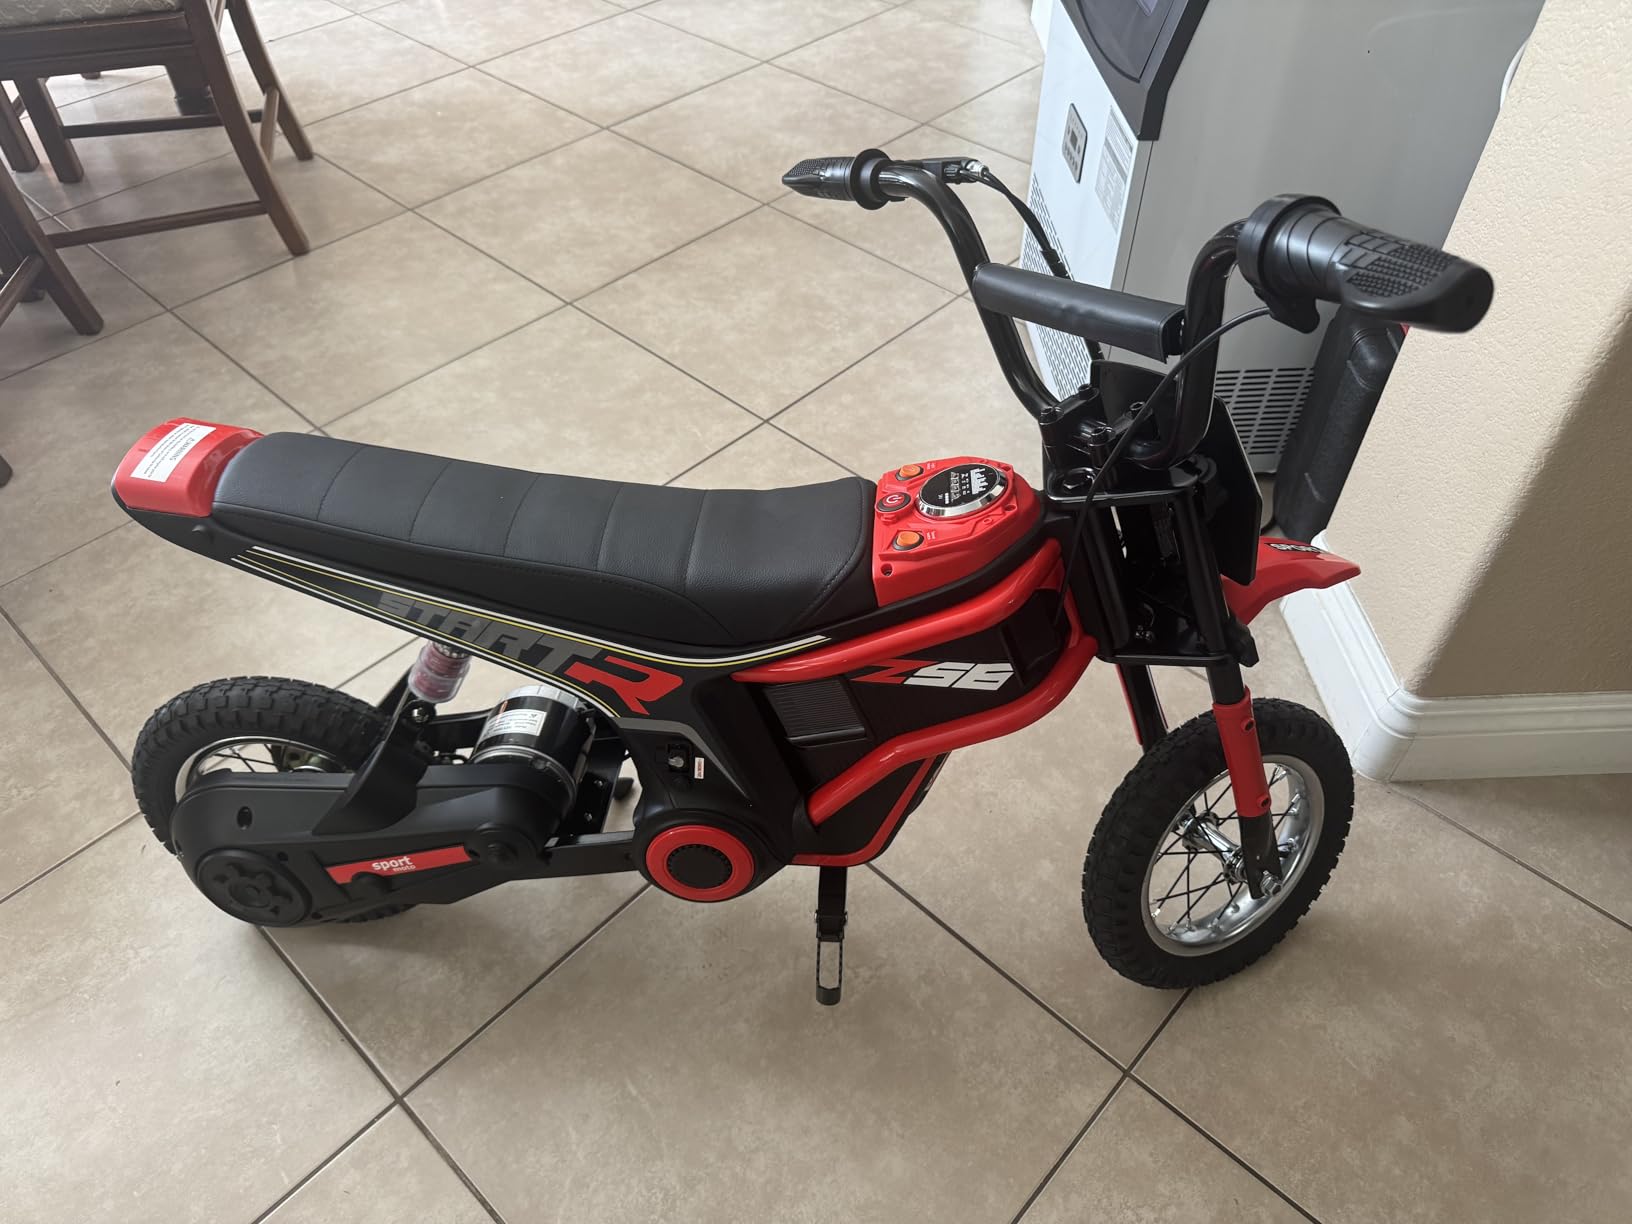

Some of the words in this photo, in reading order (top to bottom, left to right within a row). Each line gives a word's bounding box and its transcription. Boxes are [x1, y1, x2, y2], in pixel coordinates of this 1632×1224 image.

[380, 593, 600, 671] START
[565, 657, 683, 715] R
[372, 856, 413, 871] sport
